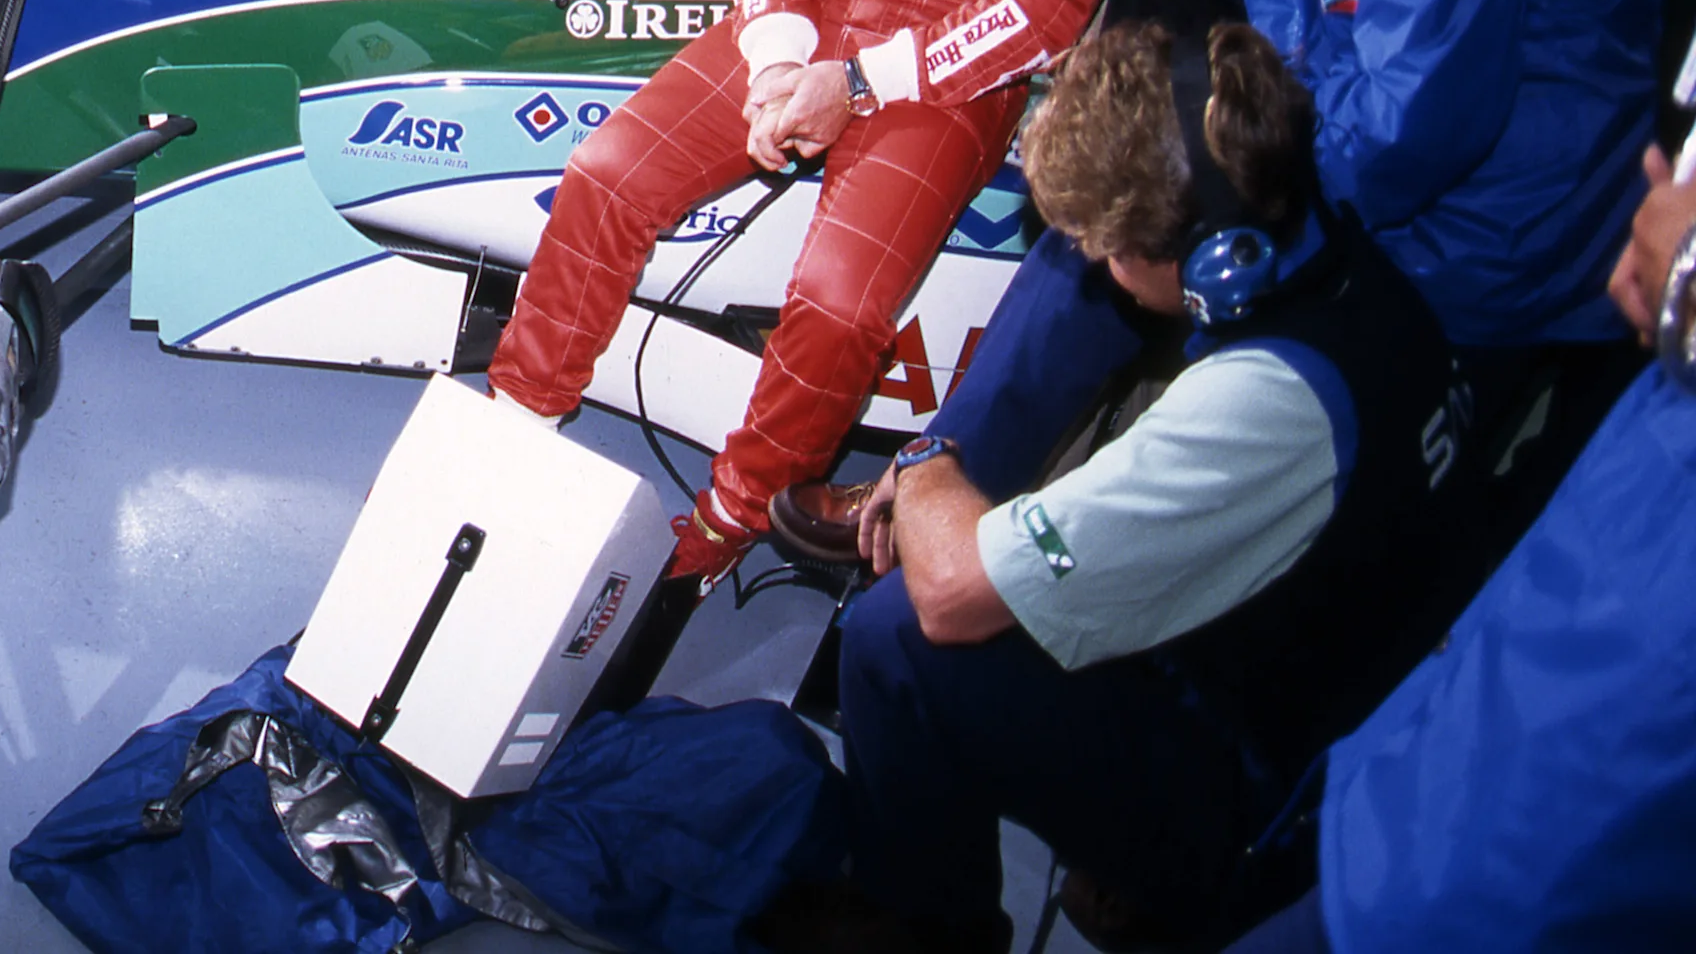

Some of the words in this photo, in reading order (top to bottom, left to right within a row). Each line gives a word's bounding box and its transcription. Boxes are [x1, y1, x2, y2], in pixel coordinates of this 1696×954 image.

[961, 6, 1018, 46] Pizza
[926, 40, 965, 74] Hut
[340, 145, 398, 163] ANTENAS
[401, 153, 440, 168] SANTA
[443, 158, 470, 171] RITA
